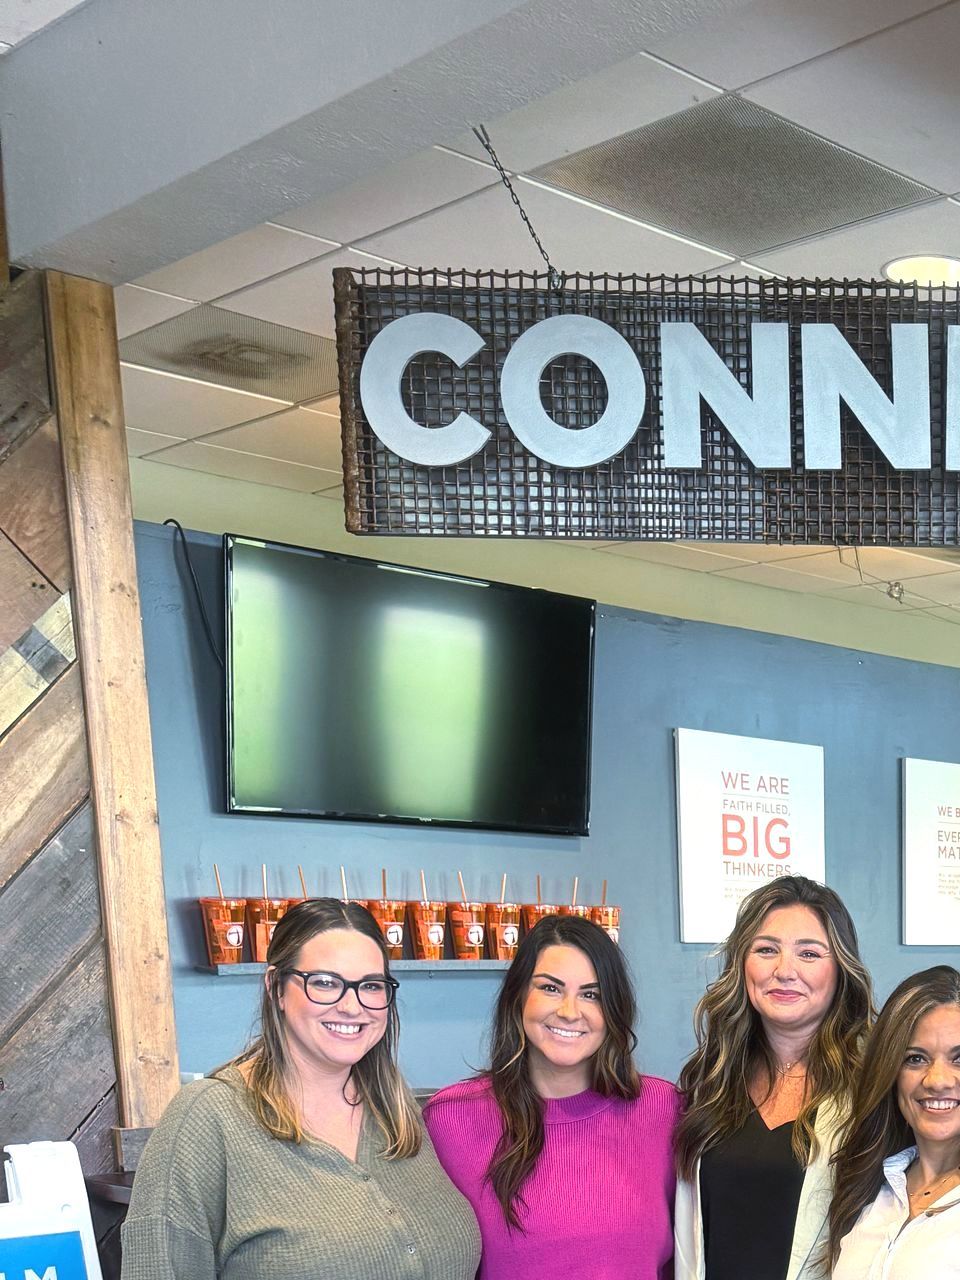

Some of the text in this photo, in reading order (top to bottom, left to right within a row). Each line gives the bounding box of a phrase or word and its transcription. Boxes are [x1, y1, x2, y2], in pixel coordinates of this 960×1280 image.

[721, 770, 789, 795] WE ARE
[723, 799, 791, 817] FAITH FILLED,
[937, 805, 952, 817] WE
[722, 813, 791, 859] BIG
[723, 861, 792, 878] THINKERS
